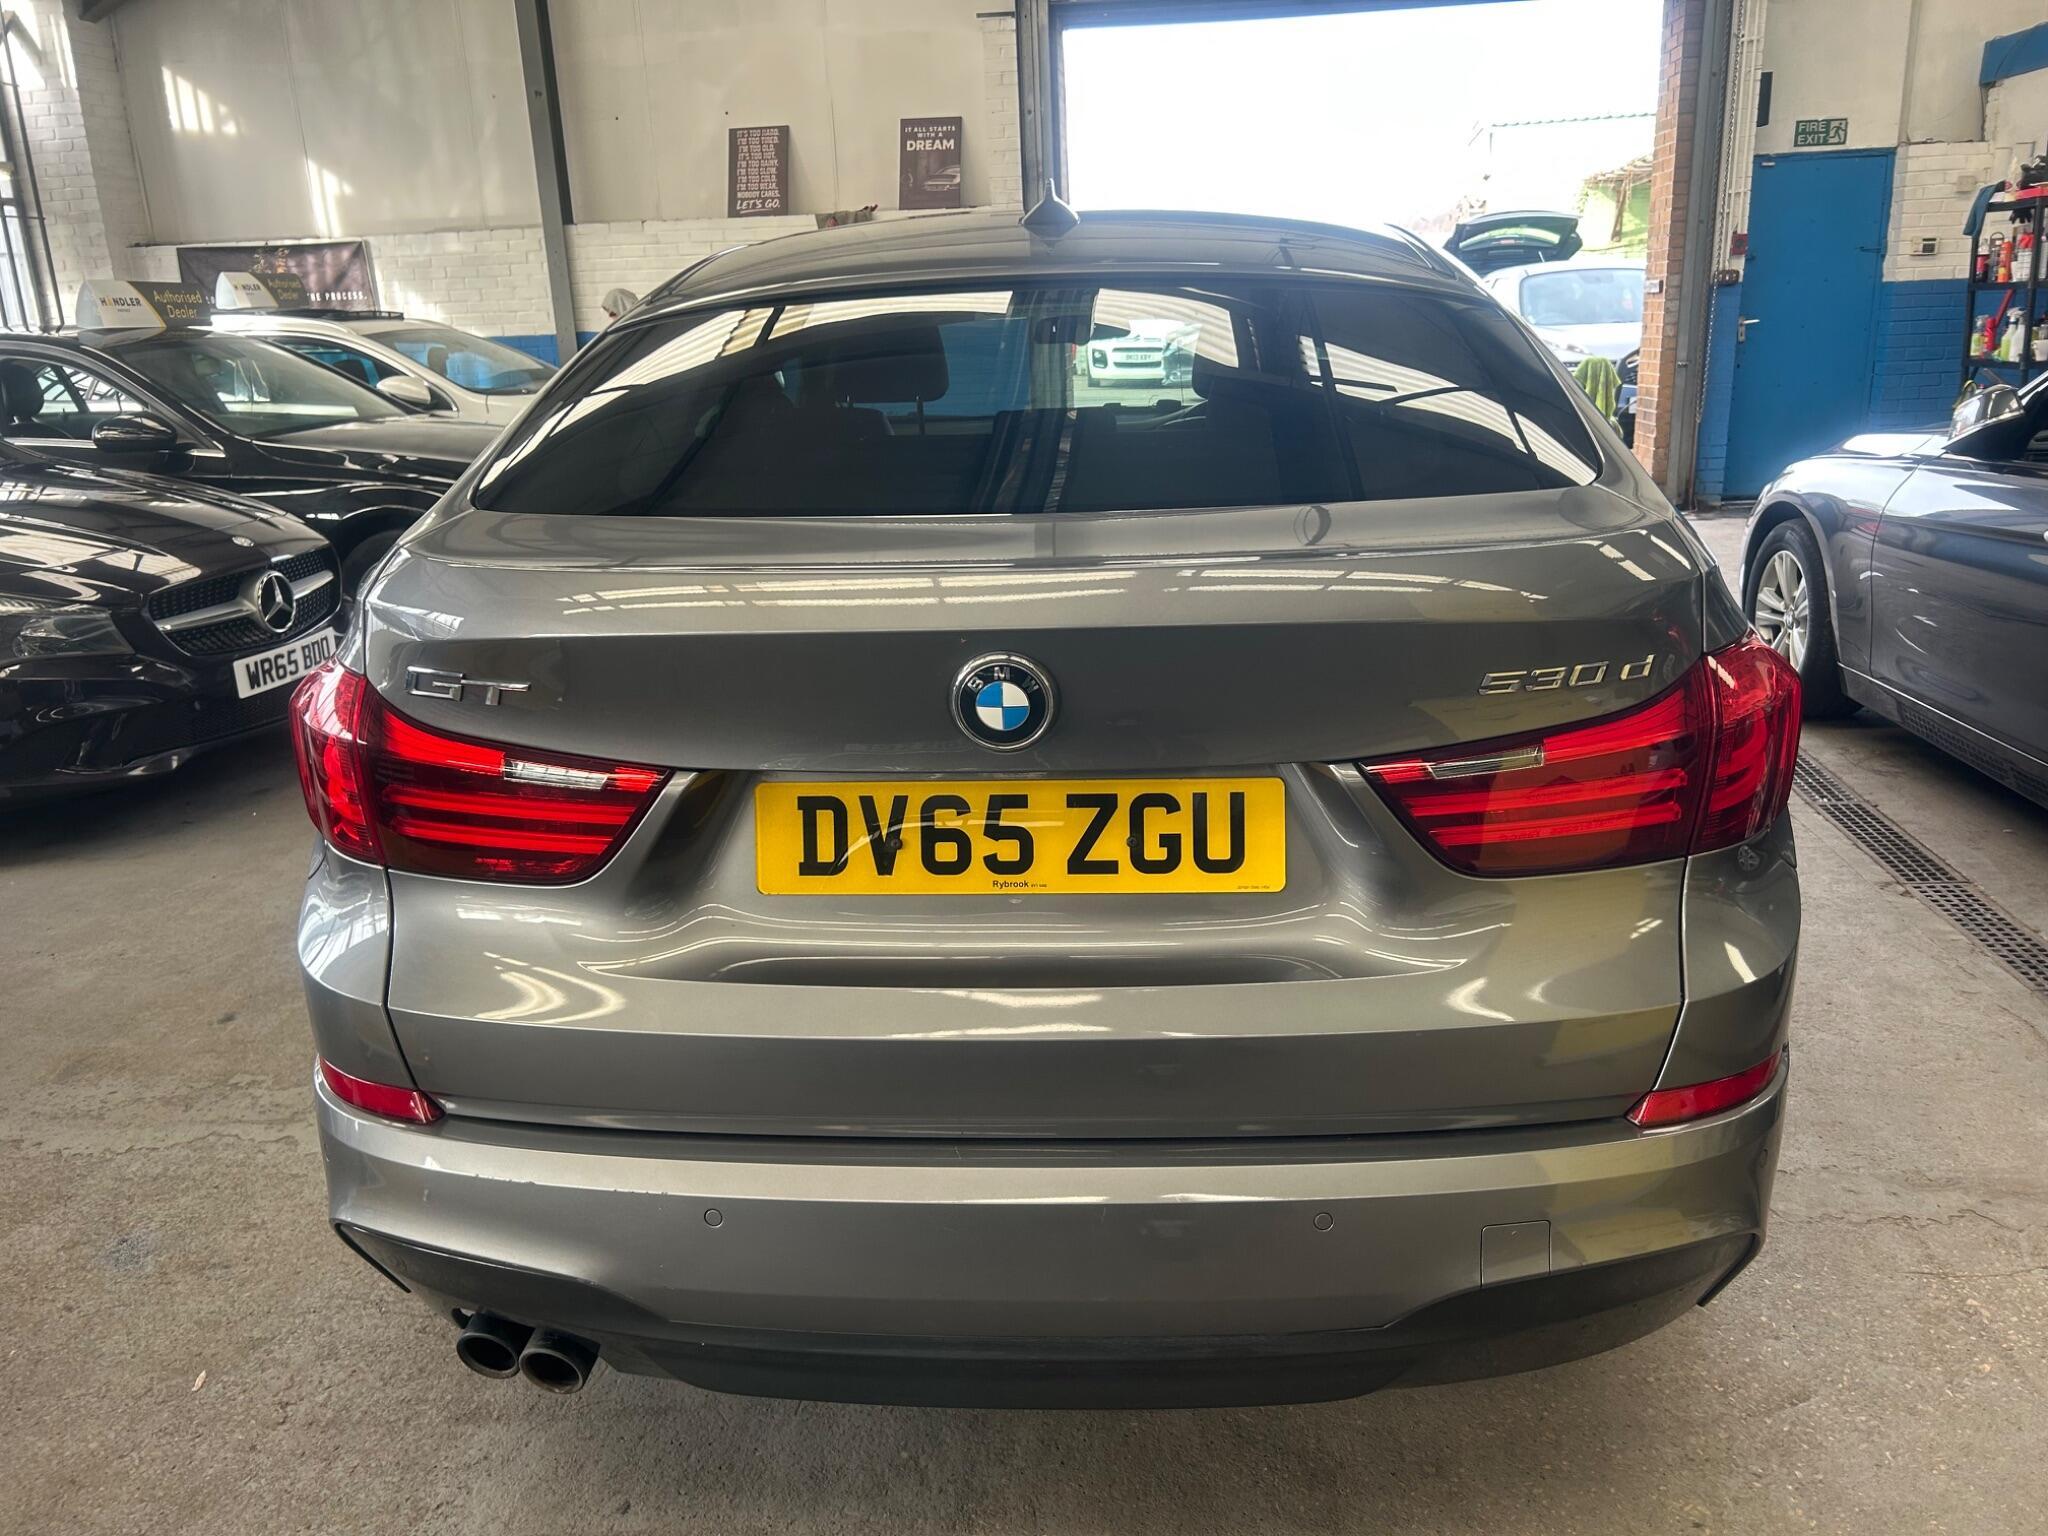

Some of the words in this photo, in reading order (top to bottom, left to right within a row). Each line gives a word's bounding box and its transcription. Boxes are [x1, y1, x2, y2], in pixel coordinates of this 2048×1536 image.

[1798, 121, 1827, 132] FIRE
[749, 129, 761, 137] TOO
[748, 137, 760, 145] TOO
[1797, 133, 1827, 145] EXIT
[749, 144, 761, 153] TOO
[906, 139, 955, 151] DREAM
[750, 152, 762, 160] TOO
[748, 160, 760, 168] TOO
[747, 167, 760, 175] TOO
[748, 175, 760, 183] TOO
[736, 199, 762, 209] LET'S
[764, 198, 781, 209] GO.
[153, 290, 203, 304] Authorised
[324, 291, 368, 300] PROCESS.
[166, 304, 198, 319] Dealer
[245, 648, 299, 690] WR65
[1478, 660, 1610, 696] 530
[1619, 653, 1656, 681] d
[404, 665, 532, 706] GT
[966, 666, 1040, 694] BMW
[796, 793, 1035, 877] DV65
[1065, 790, 1248, 876] ZGU
[992, 880, 1029, 889] Rybrook
